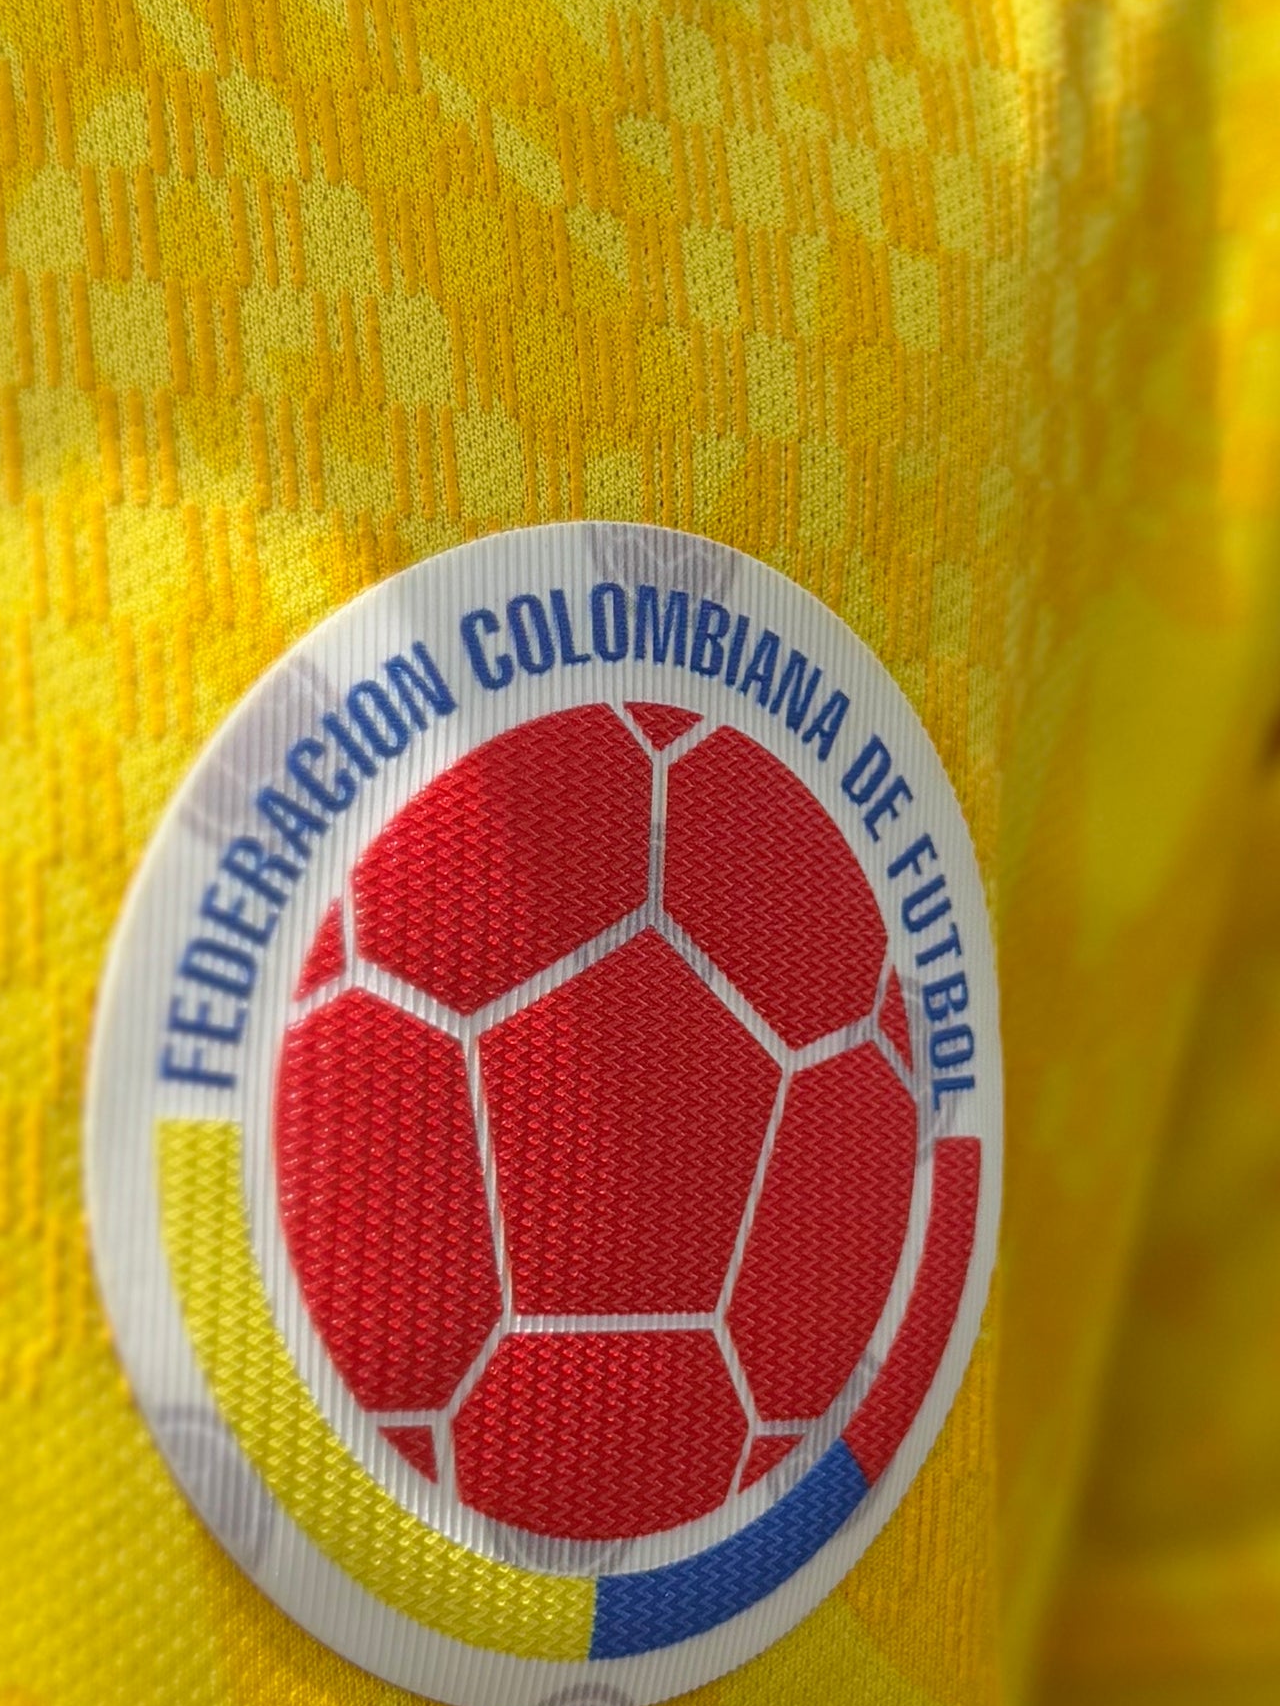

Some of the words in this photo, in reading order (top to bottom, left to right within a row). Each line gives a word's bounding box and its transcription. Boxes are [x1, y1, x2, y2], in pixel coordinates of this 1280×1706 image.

[159, 641, 457, 1089] FEDERACION
[460, 582, 850, 762] COLOMBIANA
[840, 734, 913, 843] DE
[887, 832, 976, 1110] FUTBOL
